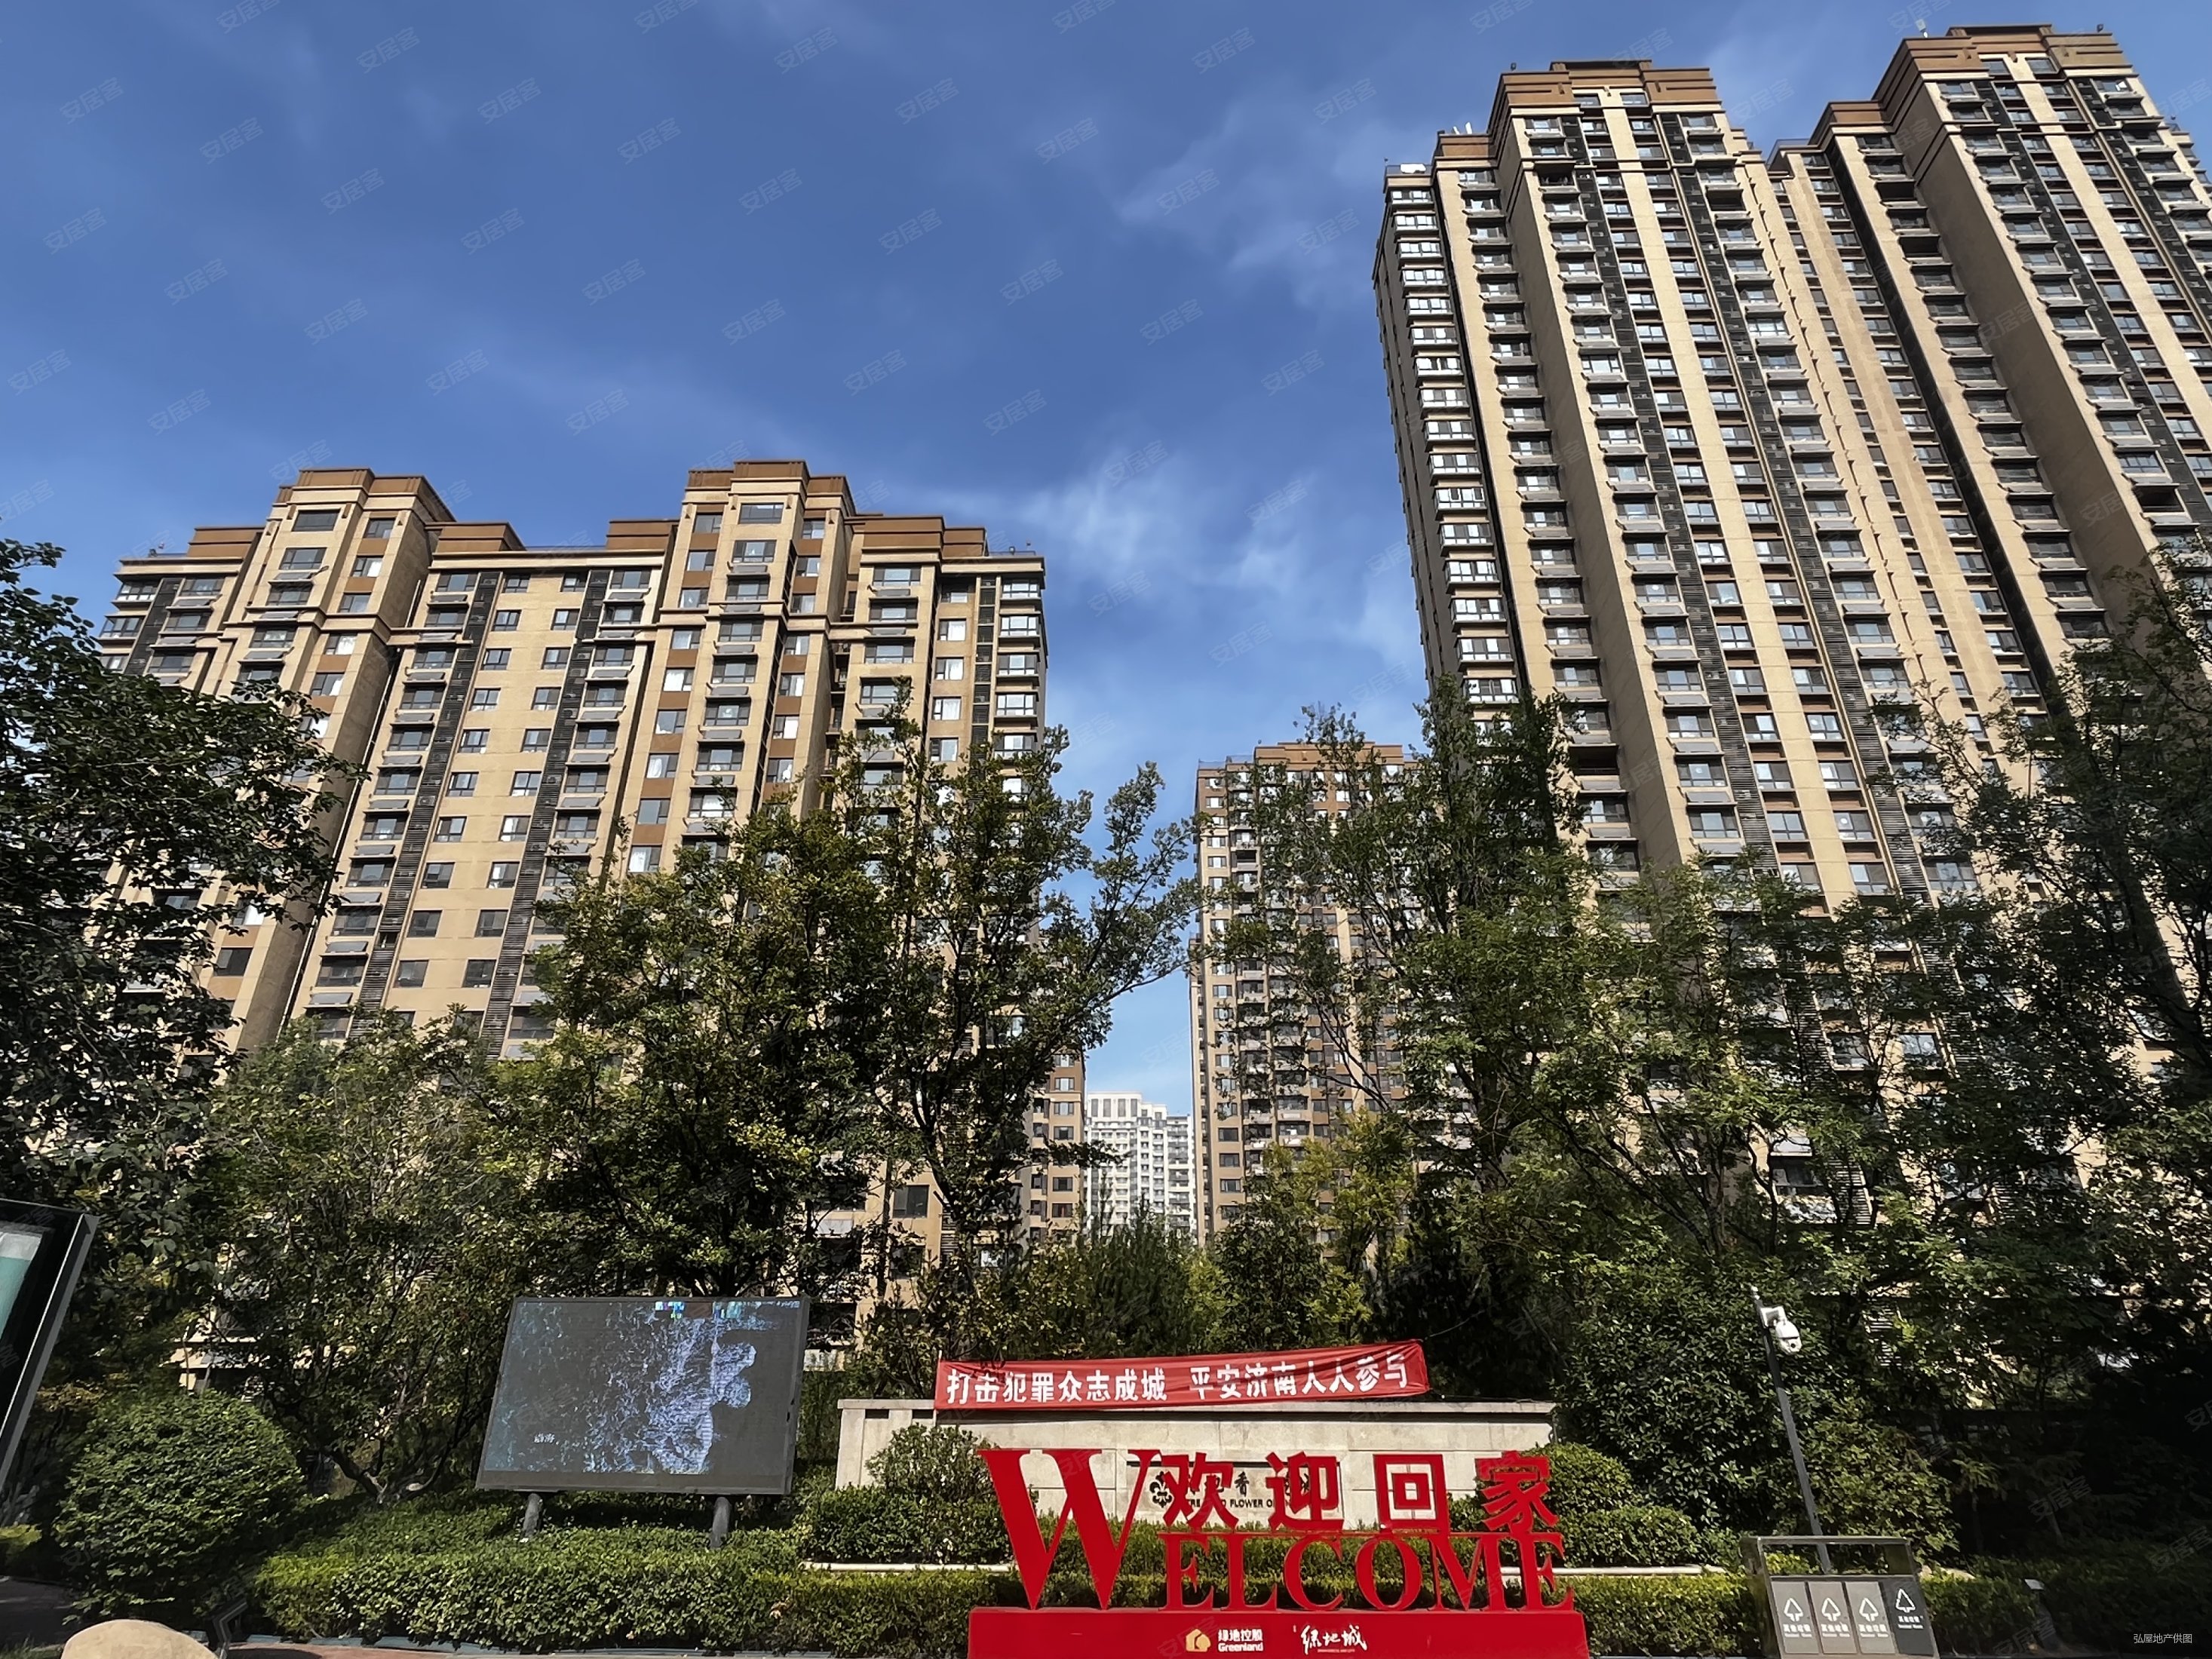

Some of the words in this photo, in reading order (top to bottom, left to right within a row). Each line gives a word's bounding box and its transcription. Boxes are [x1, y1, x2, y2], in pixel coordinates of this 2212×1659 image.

[946, 1366, 1167, 1405] 打击犯罪众志成城
[1189, 1350, 1407, 1400] 平安济南人人参与
[1161, 1449, 1560, 1533] 欢迎回家
[1230, 1498, 1263, 1507] FLOWER
[980, 1449, 1575, 1611] WELCOME
[1218, 1642, 1264, 1652] Greenland
